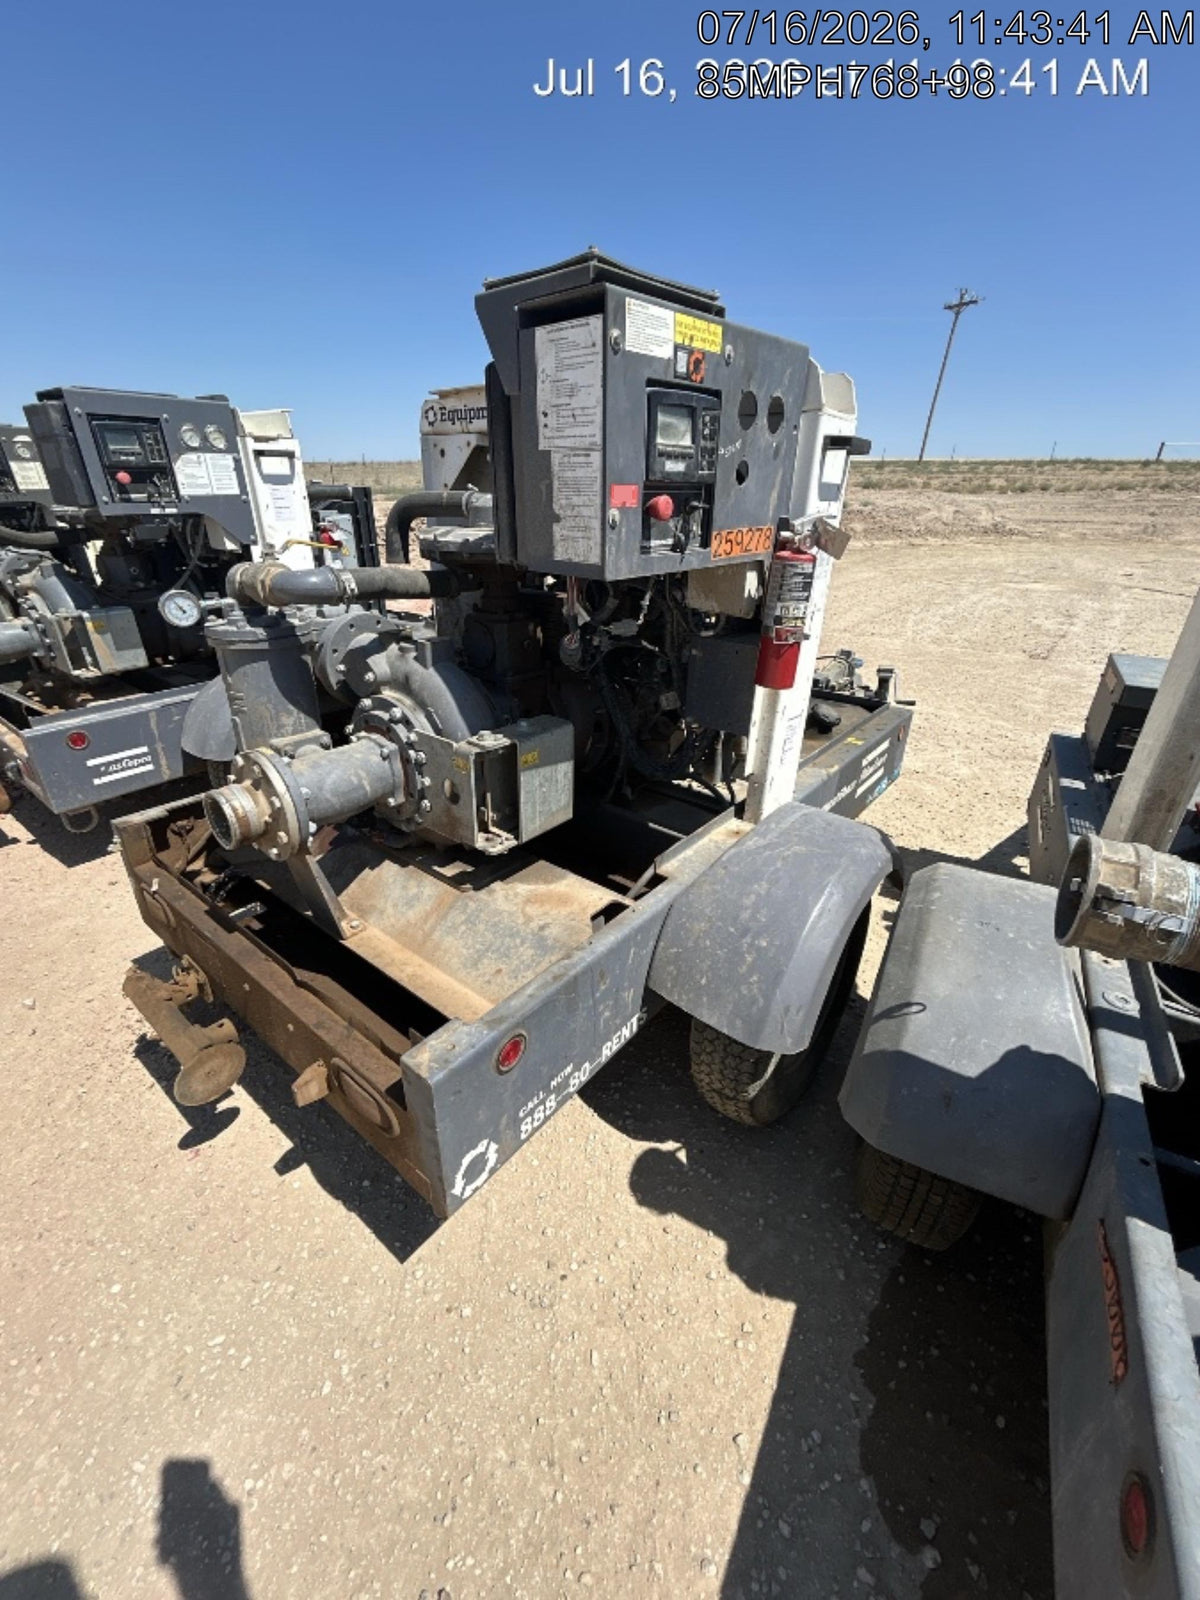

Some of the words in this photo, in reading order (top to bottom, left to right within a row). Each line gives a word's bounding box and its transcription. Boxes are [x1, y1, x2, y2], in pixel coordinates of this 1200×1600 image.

[713, 527, 773, 559] 259278
[518, 1090, 546, 1118] CALL
[550, 1062, 574, 1090] NOW
